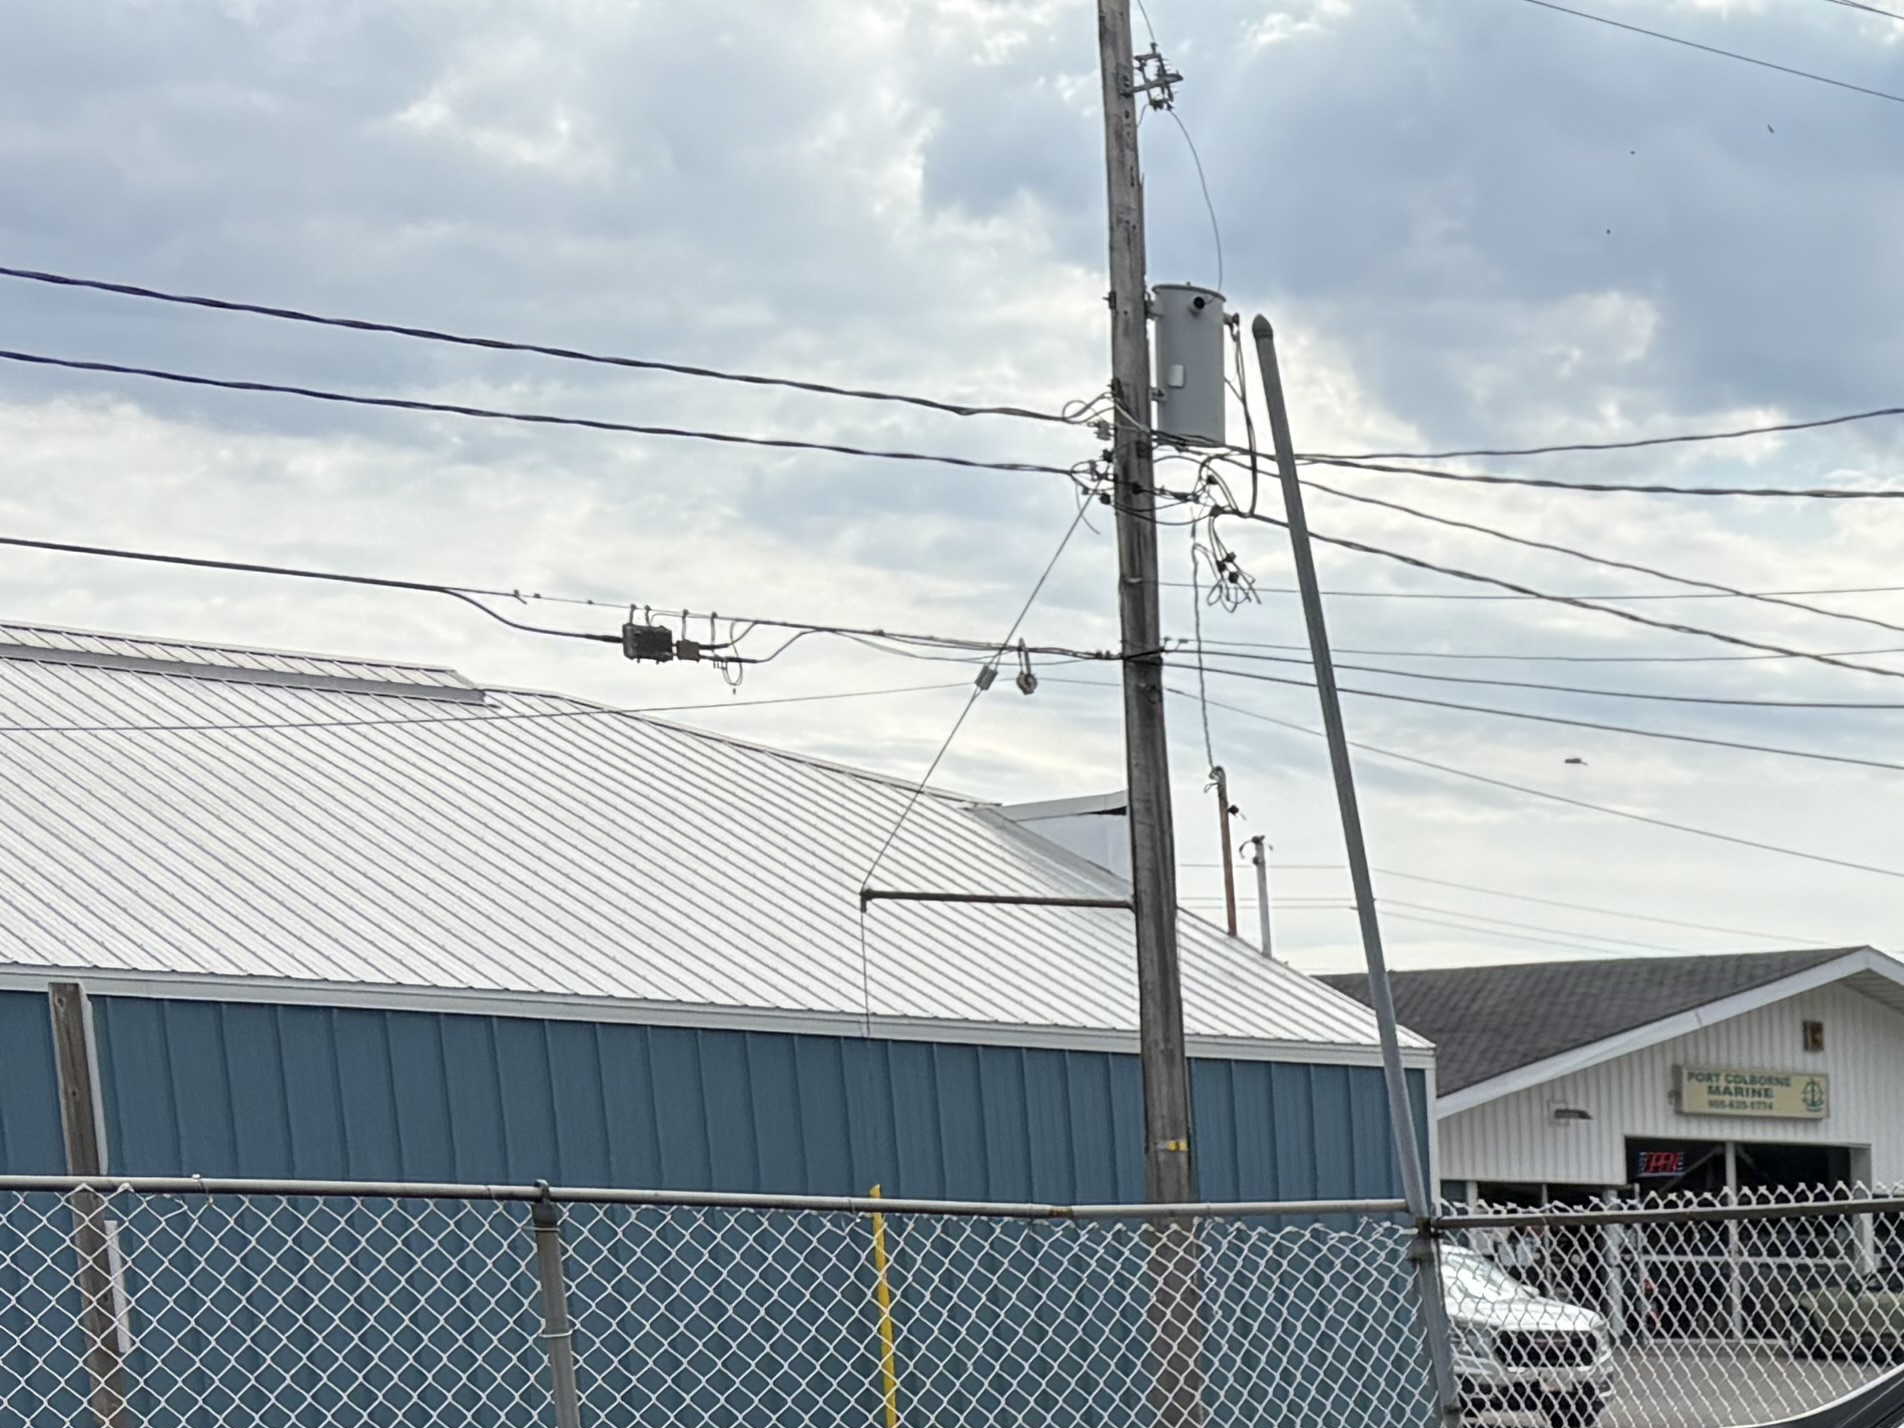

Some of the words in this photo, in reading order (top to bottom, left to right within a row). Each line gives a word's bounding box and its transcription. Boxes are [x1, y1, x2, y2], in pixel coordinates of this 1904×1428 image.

[1687, 1071, 1721, 1083] PORT
[1724, 1074, 1792, 1087] COLBORNE
[1707, 1085, 1774, 1099] MARINE
